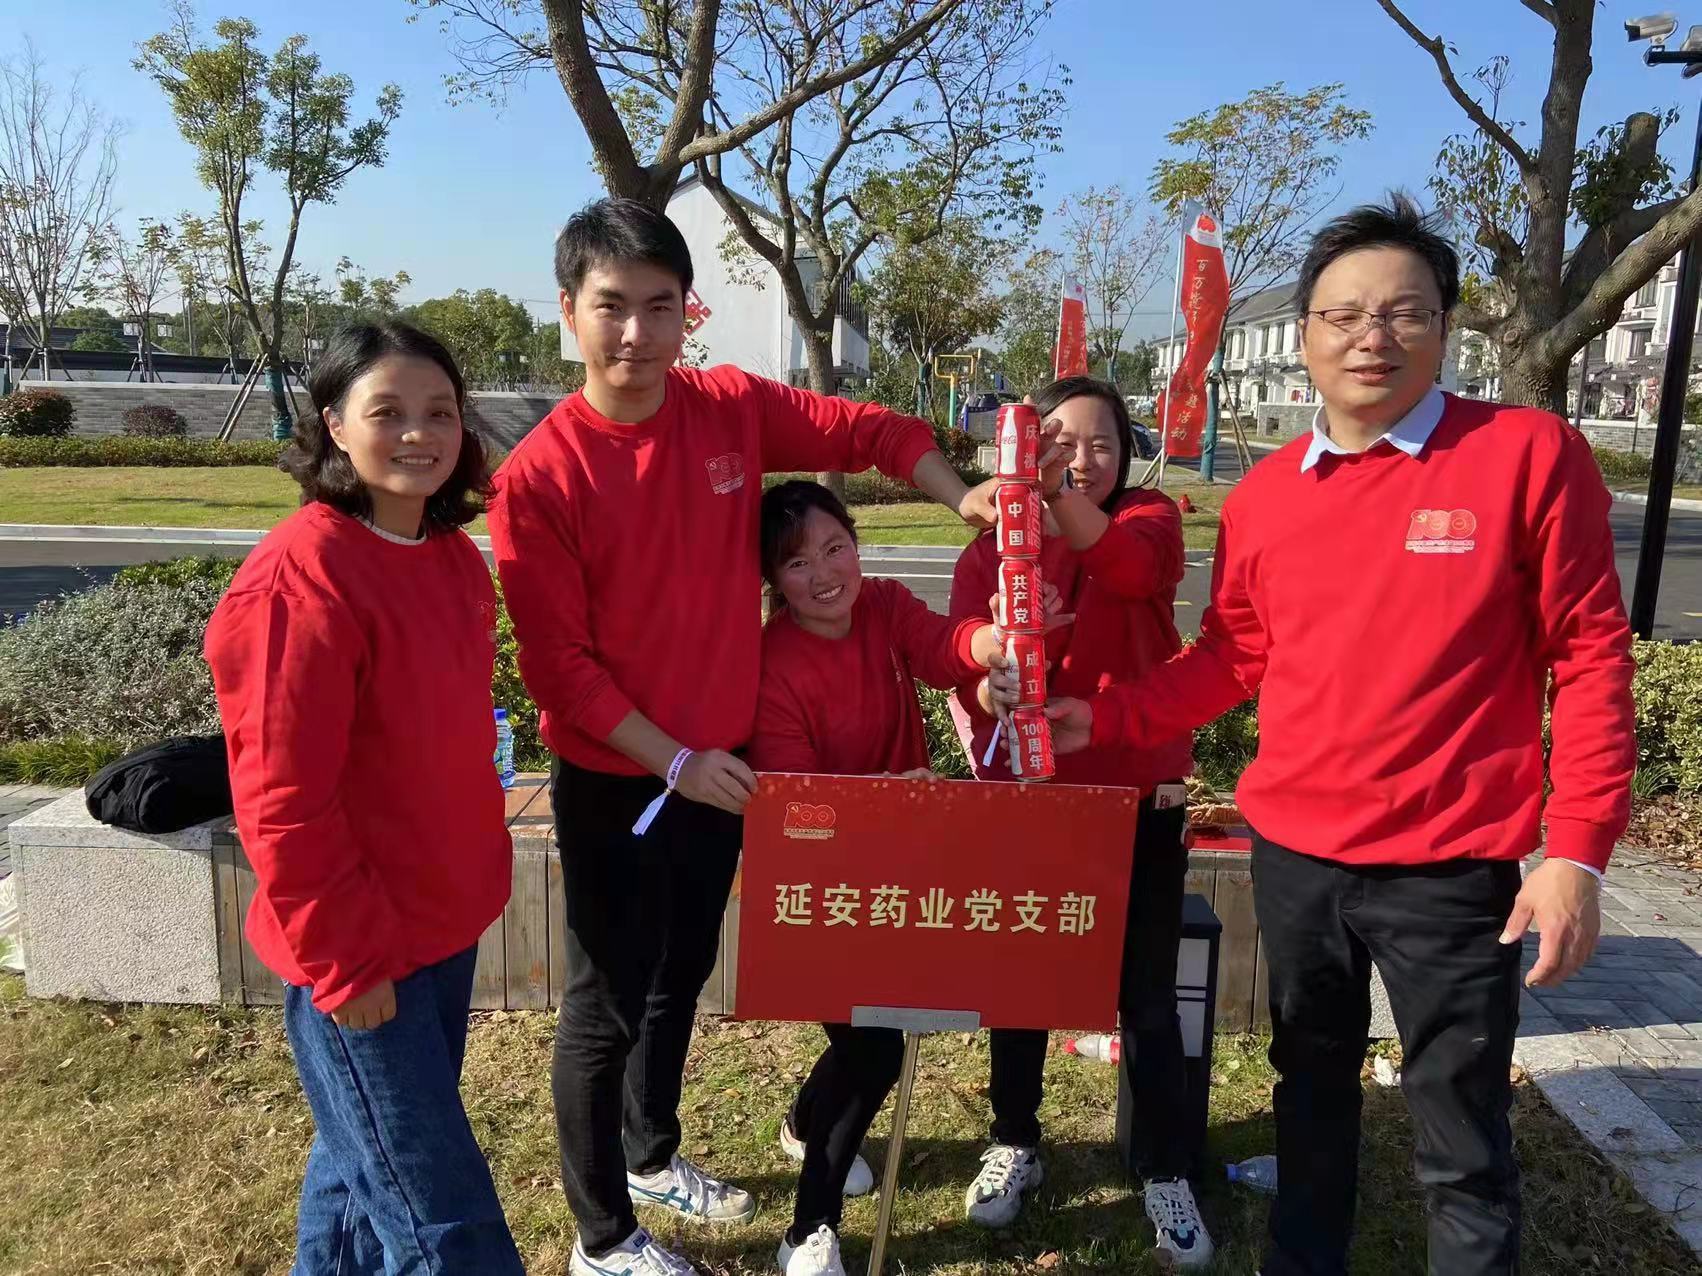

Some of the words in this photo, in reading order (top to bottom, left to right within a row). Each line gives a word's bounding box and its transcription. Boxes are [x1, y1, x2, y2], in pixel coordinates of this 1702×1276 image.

[1007, 501, 1024, 546] 中国
[1012, 574, 1029, 624] 共产党
[1025, 650, 1041, 695] 成立
[773, 883, 1097, 936] 延安药业党支部
